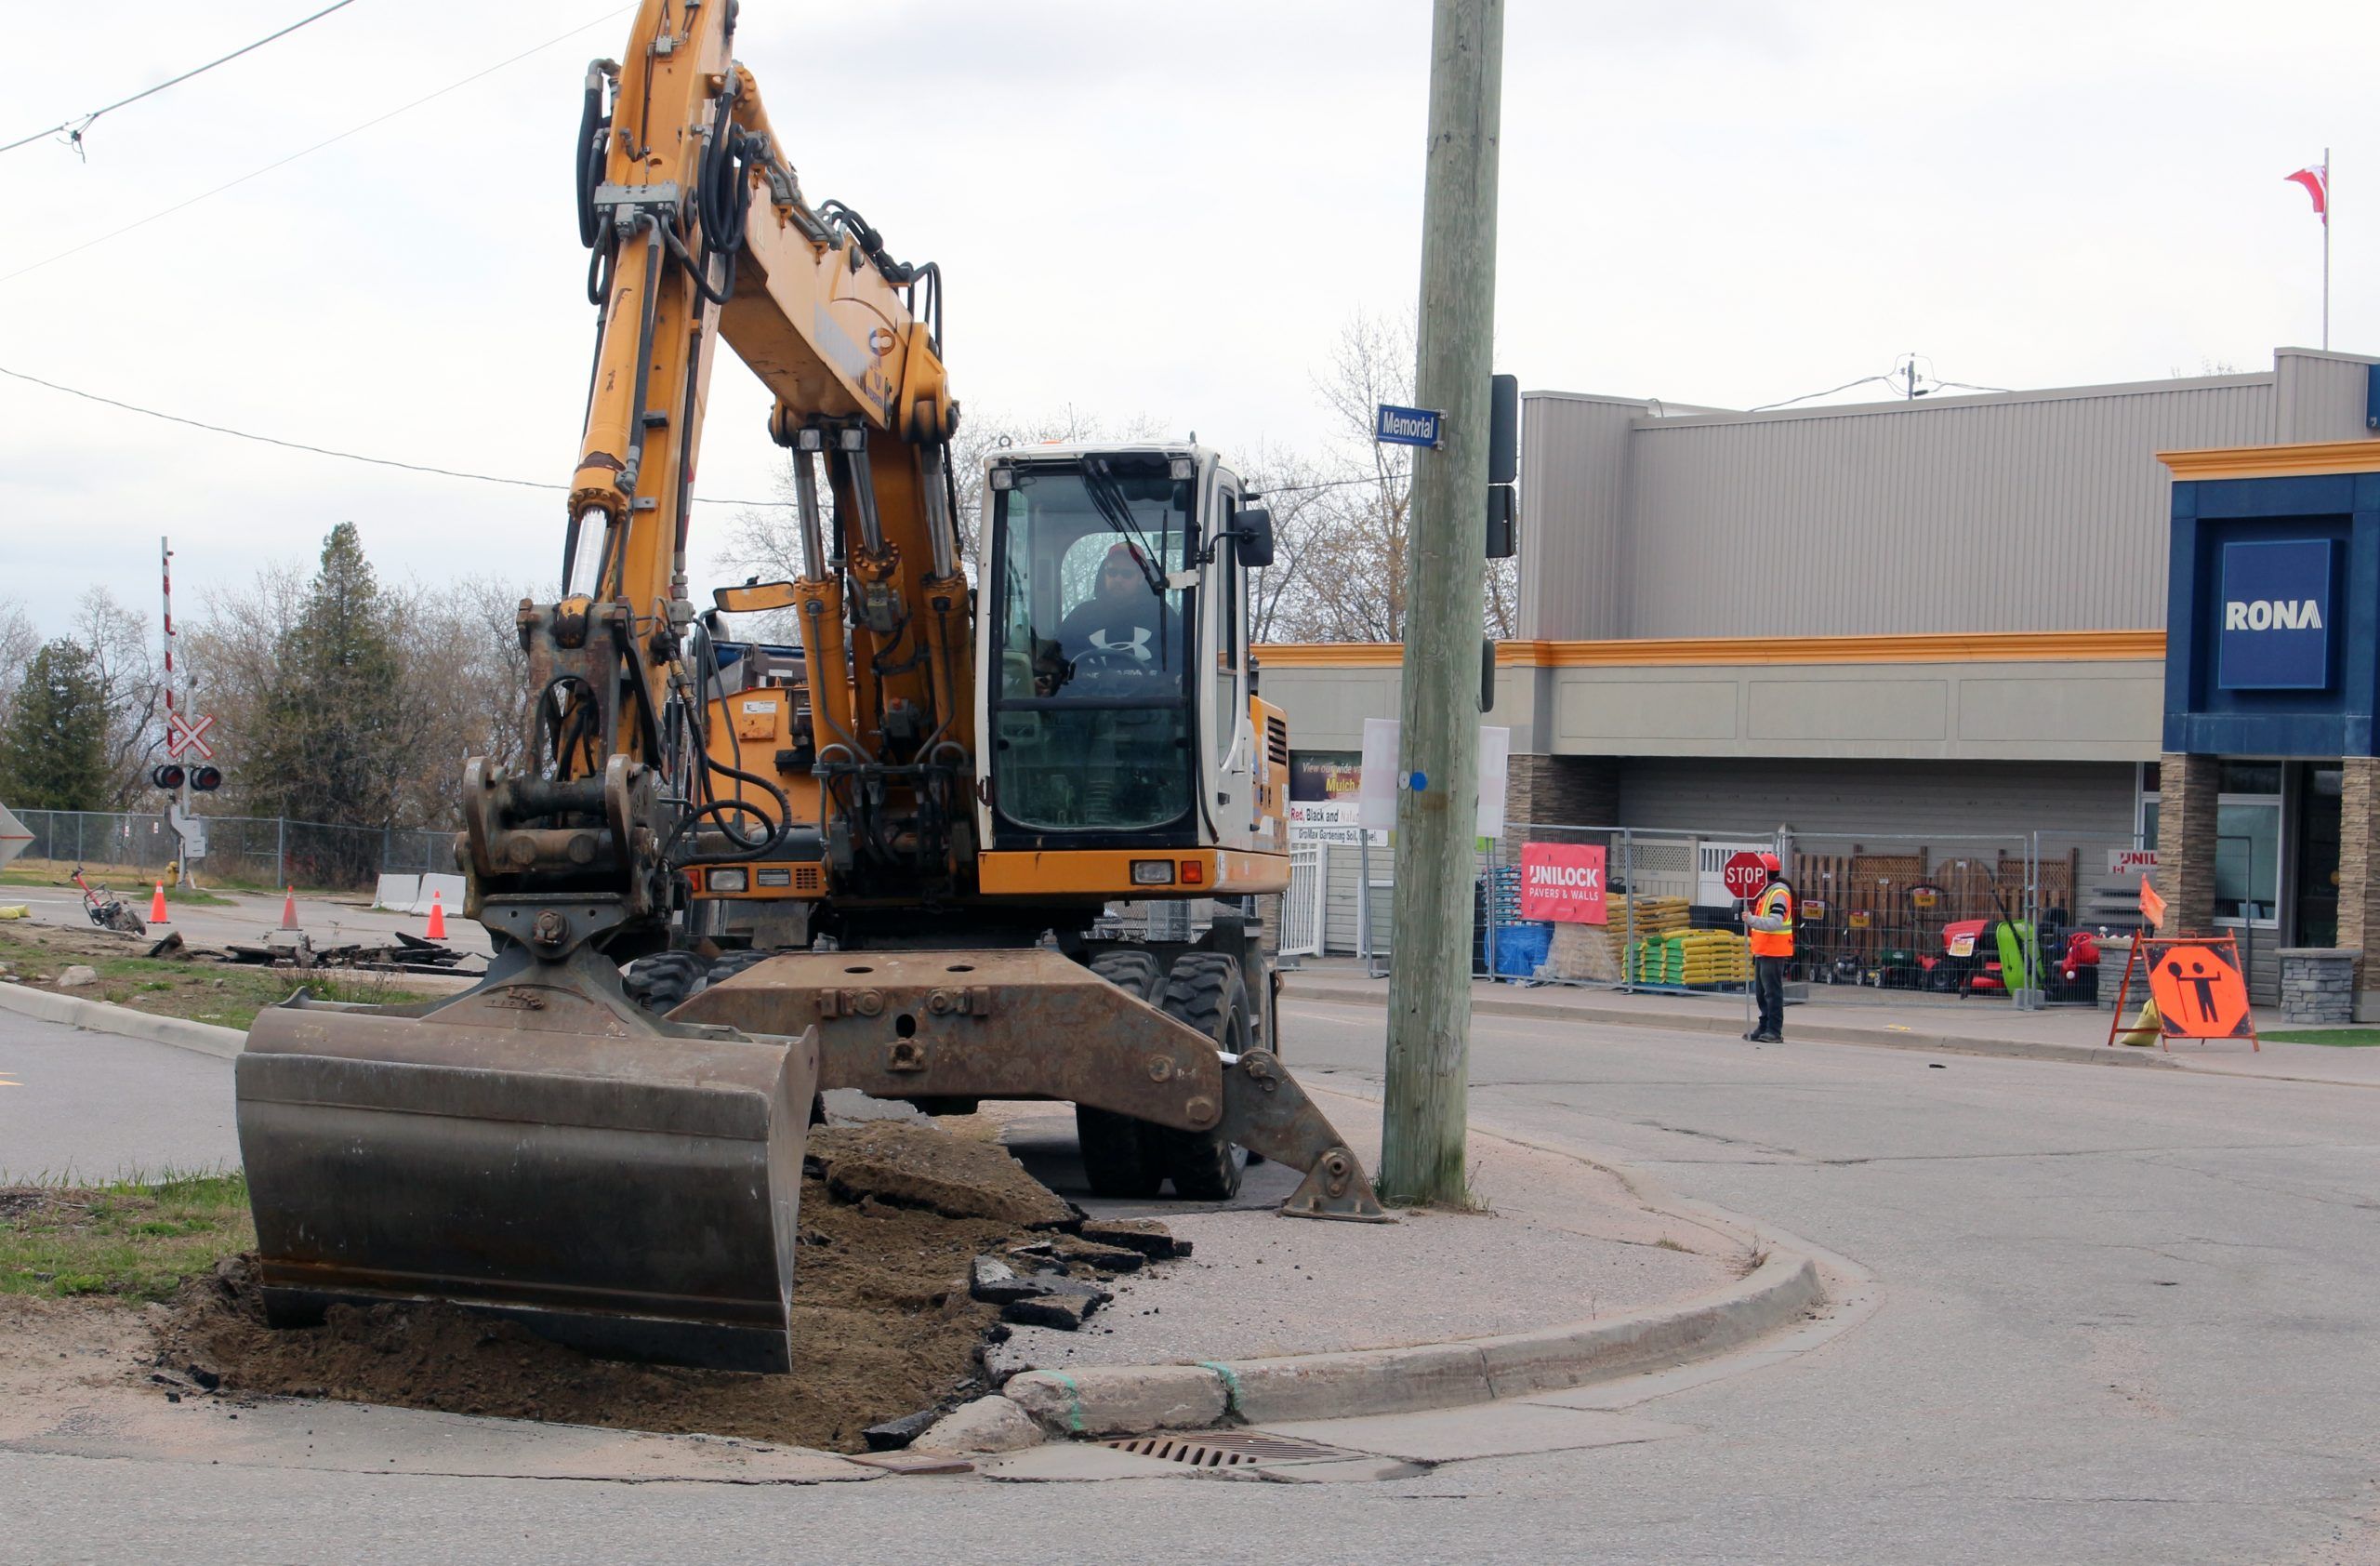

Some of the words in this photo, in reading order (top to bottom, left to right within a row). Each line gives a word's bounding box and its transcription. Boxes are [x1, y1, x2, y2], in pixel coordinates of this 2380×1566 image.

[1383, 411, 1435, 439] Memorial
[2226, 600, 2322, 631] RONA
[1302, 762, 1319, 773] View
[1321, 764, 1334, 774] our
[1336, 763, 1352, 774] wide
[1326, 777, 1355, 792] Mulch
[1290, 807, 1305, 823] Red,
[1306, 808, 1324, 822] Black
[1326, 808, 1339, 822] and
[1320, 829, 1345, 843] Gardening
[1529, 865, 1599, 887] UNILOCK
[1726, 867, 1765, 883] STOP
[1529, 887, 1559, 899] PAVERS
[1562, 890, 1568, 899] &
[1570, 889, 1599, 901] WALLS
